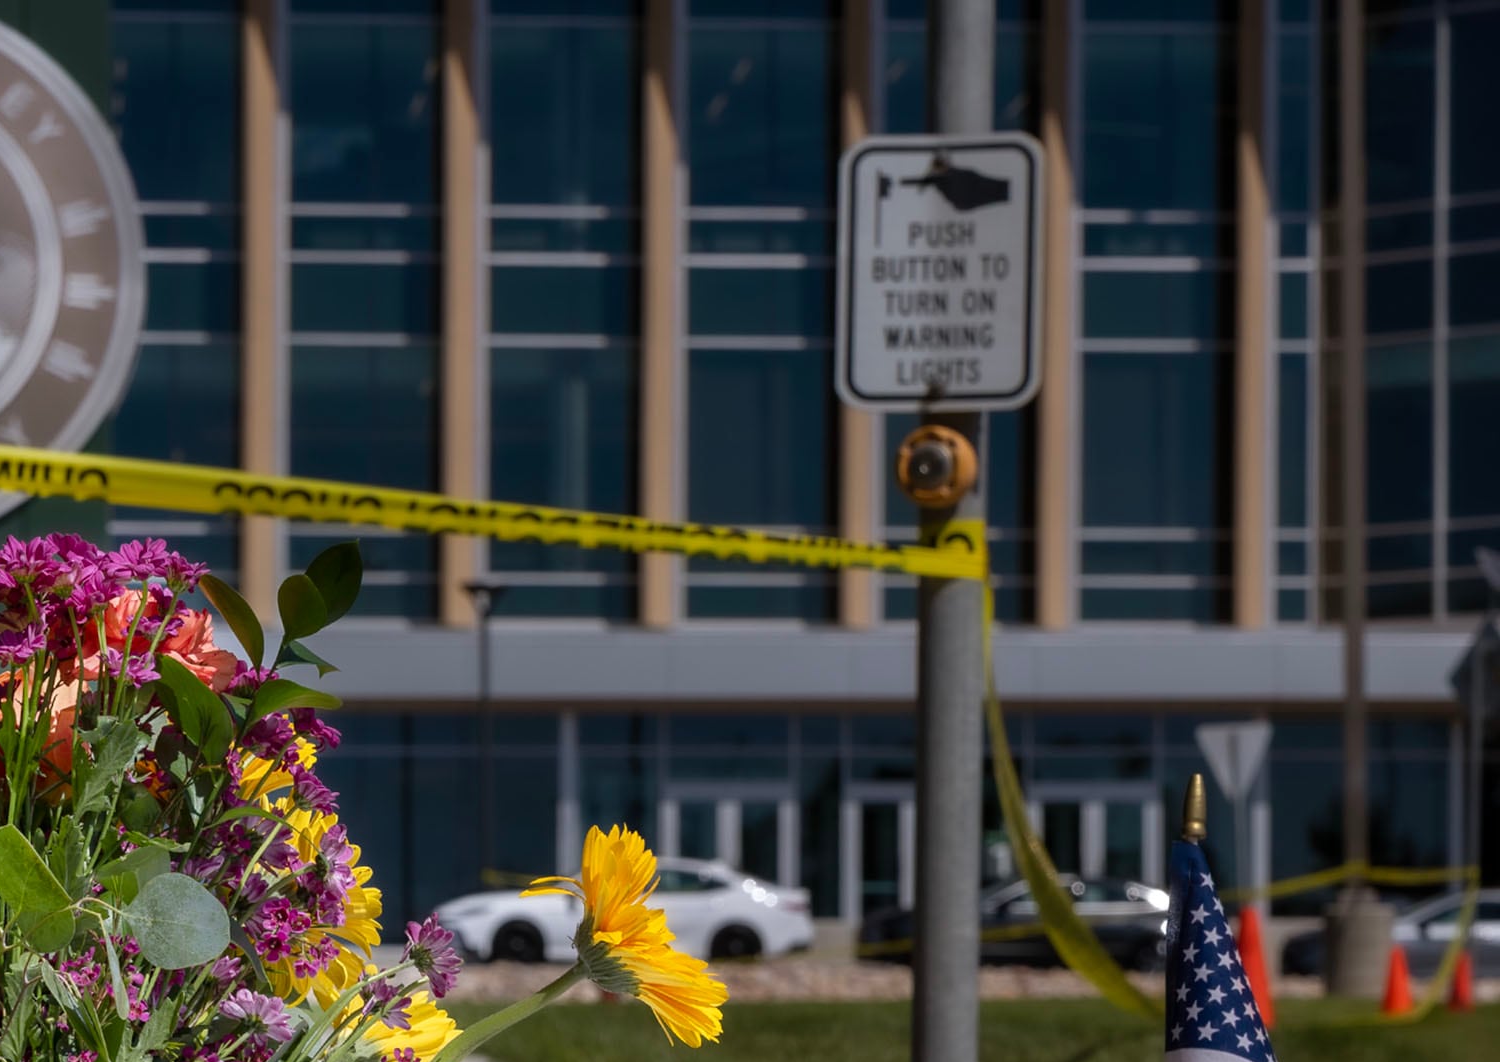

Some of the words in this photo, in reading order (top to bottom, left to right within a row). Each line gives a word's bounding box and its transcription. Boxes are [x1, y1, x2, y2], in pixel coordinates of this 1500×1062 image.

[908, 221, 976, 248] PUSH
[871, 256, 967, 284] BUTTON
[979, 255, 1010, 281] TO
[885, 290, 948, 317] TURN
[962, 290, 997, 316] ON
[883, 325, 995, 351] WARNING
[896, 358, 982, 386] LIGHTS
